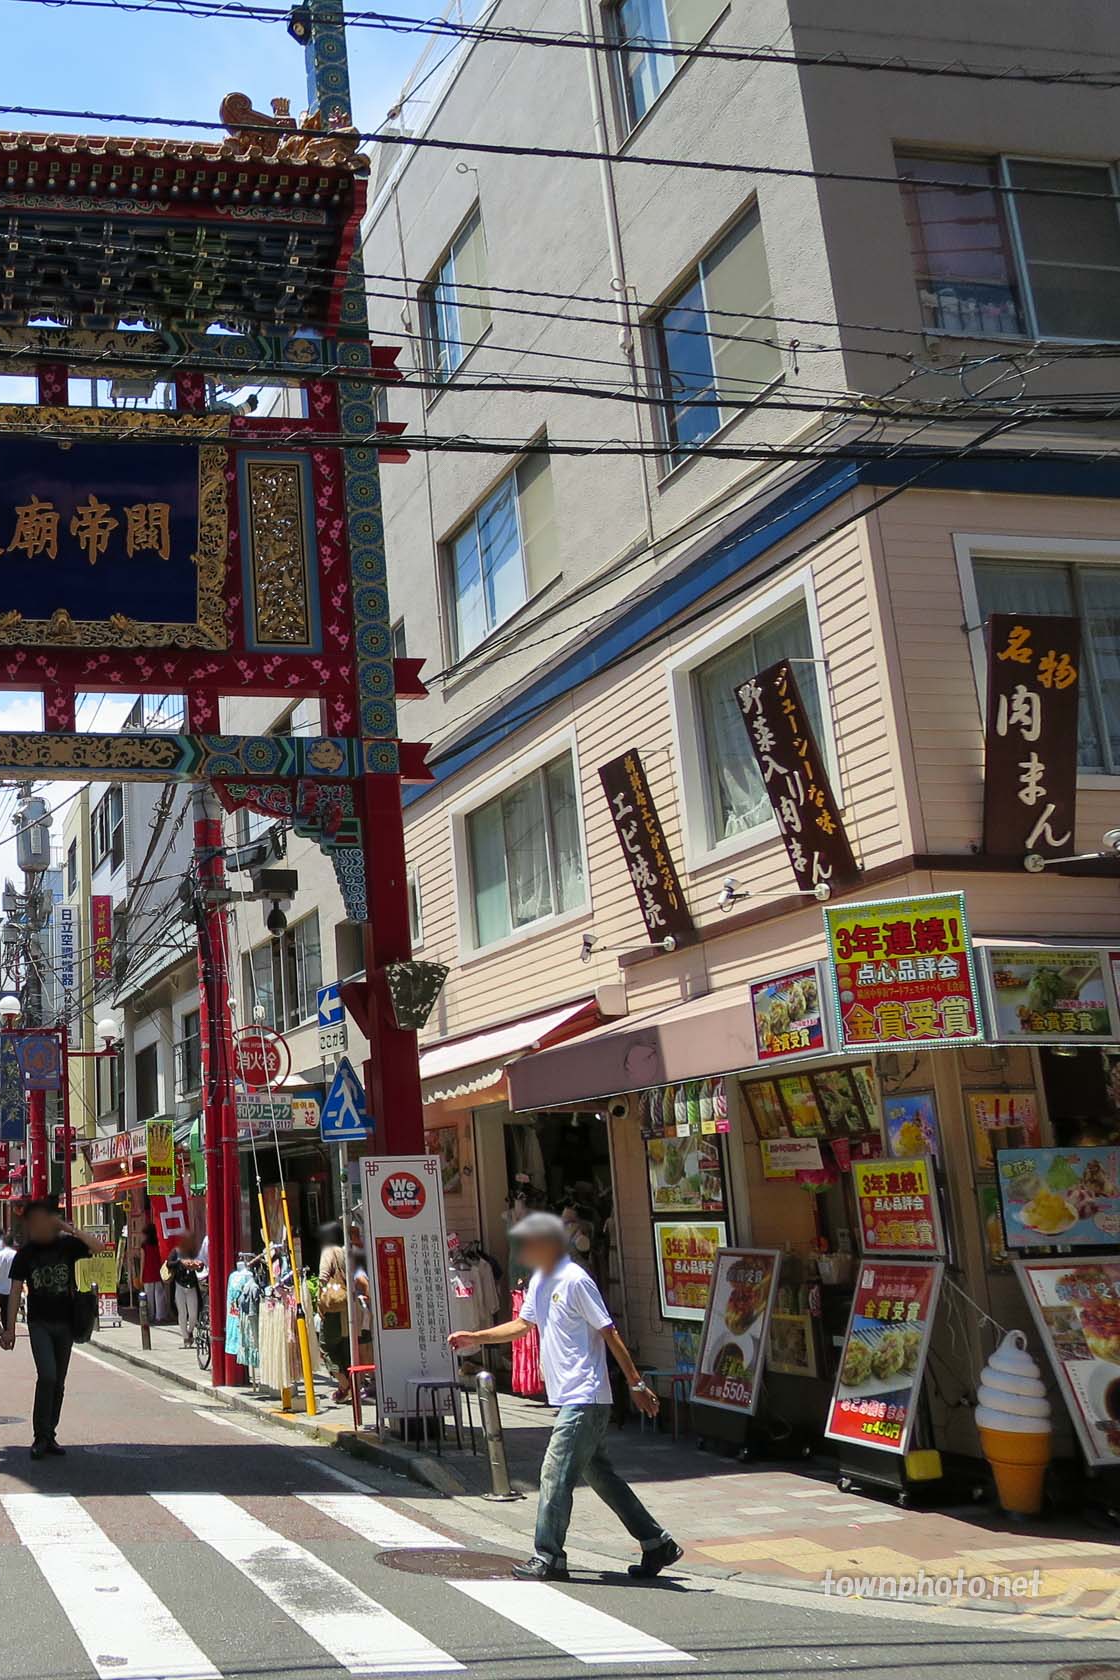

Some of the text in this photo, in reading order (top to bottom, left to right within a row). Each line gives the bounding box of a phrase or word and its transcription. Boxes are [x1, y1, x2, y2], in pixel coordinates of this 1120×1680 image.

[997, 625, 1077, 690] 名物
[997, 684, 1072, 850] 肉まん
[738, 679, 833, 884] 野菜入り肉まん
[612, 791, 667, 929] エビ焼売
[836, 916, 961, 960] 3年連続!
[856, 955, 960, 986] 点心品評会
[844, 995, 976, 1042] 金賞受賞
[1031, 1011, 1096, 1032] 金賞受賞
[319, 1031, 345, 1051] ここから
[772, 1028, 811, 1054] 金賞受賞
[236, 1051, 277, 1072] 消火栓
[389, 1179, 416, 1191] We
[394, 1190, 414, 1199] are
[862, 1172, 924, 1195] 3年連続!
[872, 1196, 926, 1212] 点心品評会
[875, 1221, 935, 1246] 金賞受賞
[864, 1299, 921, 1322] 金賞受賞
